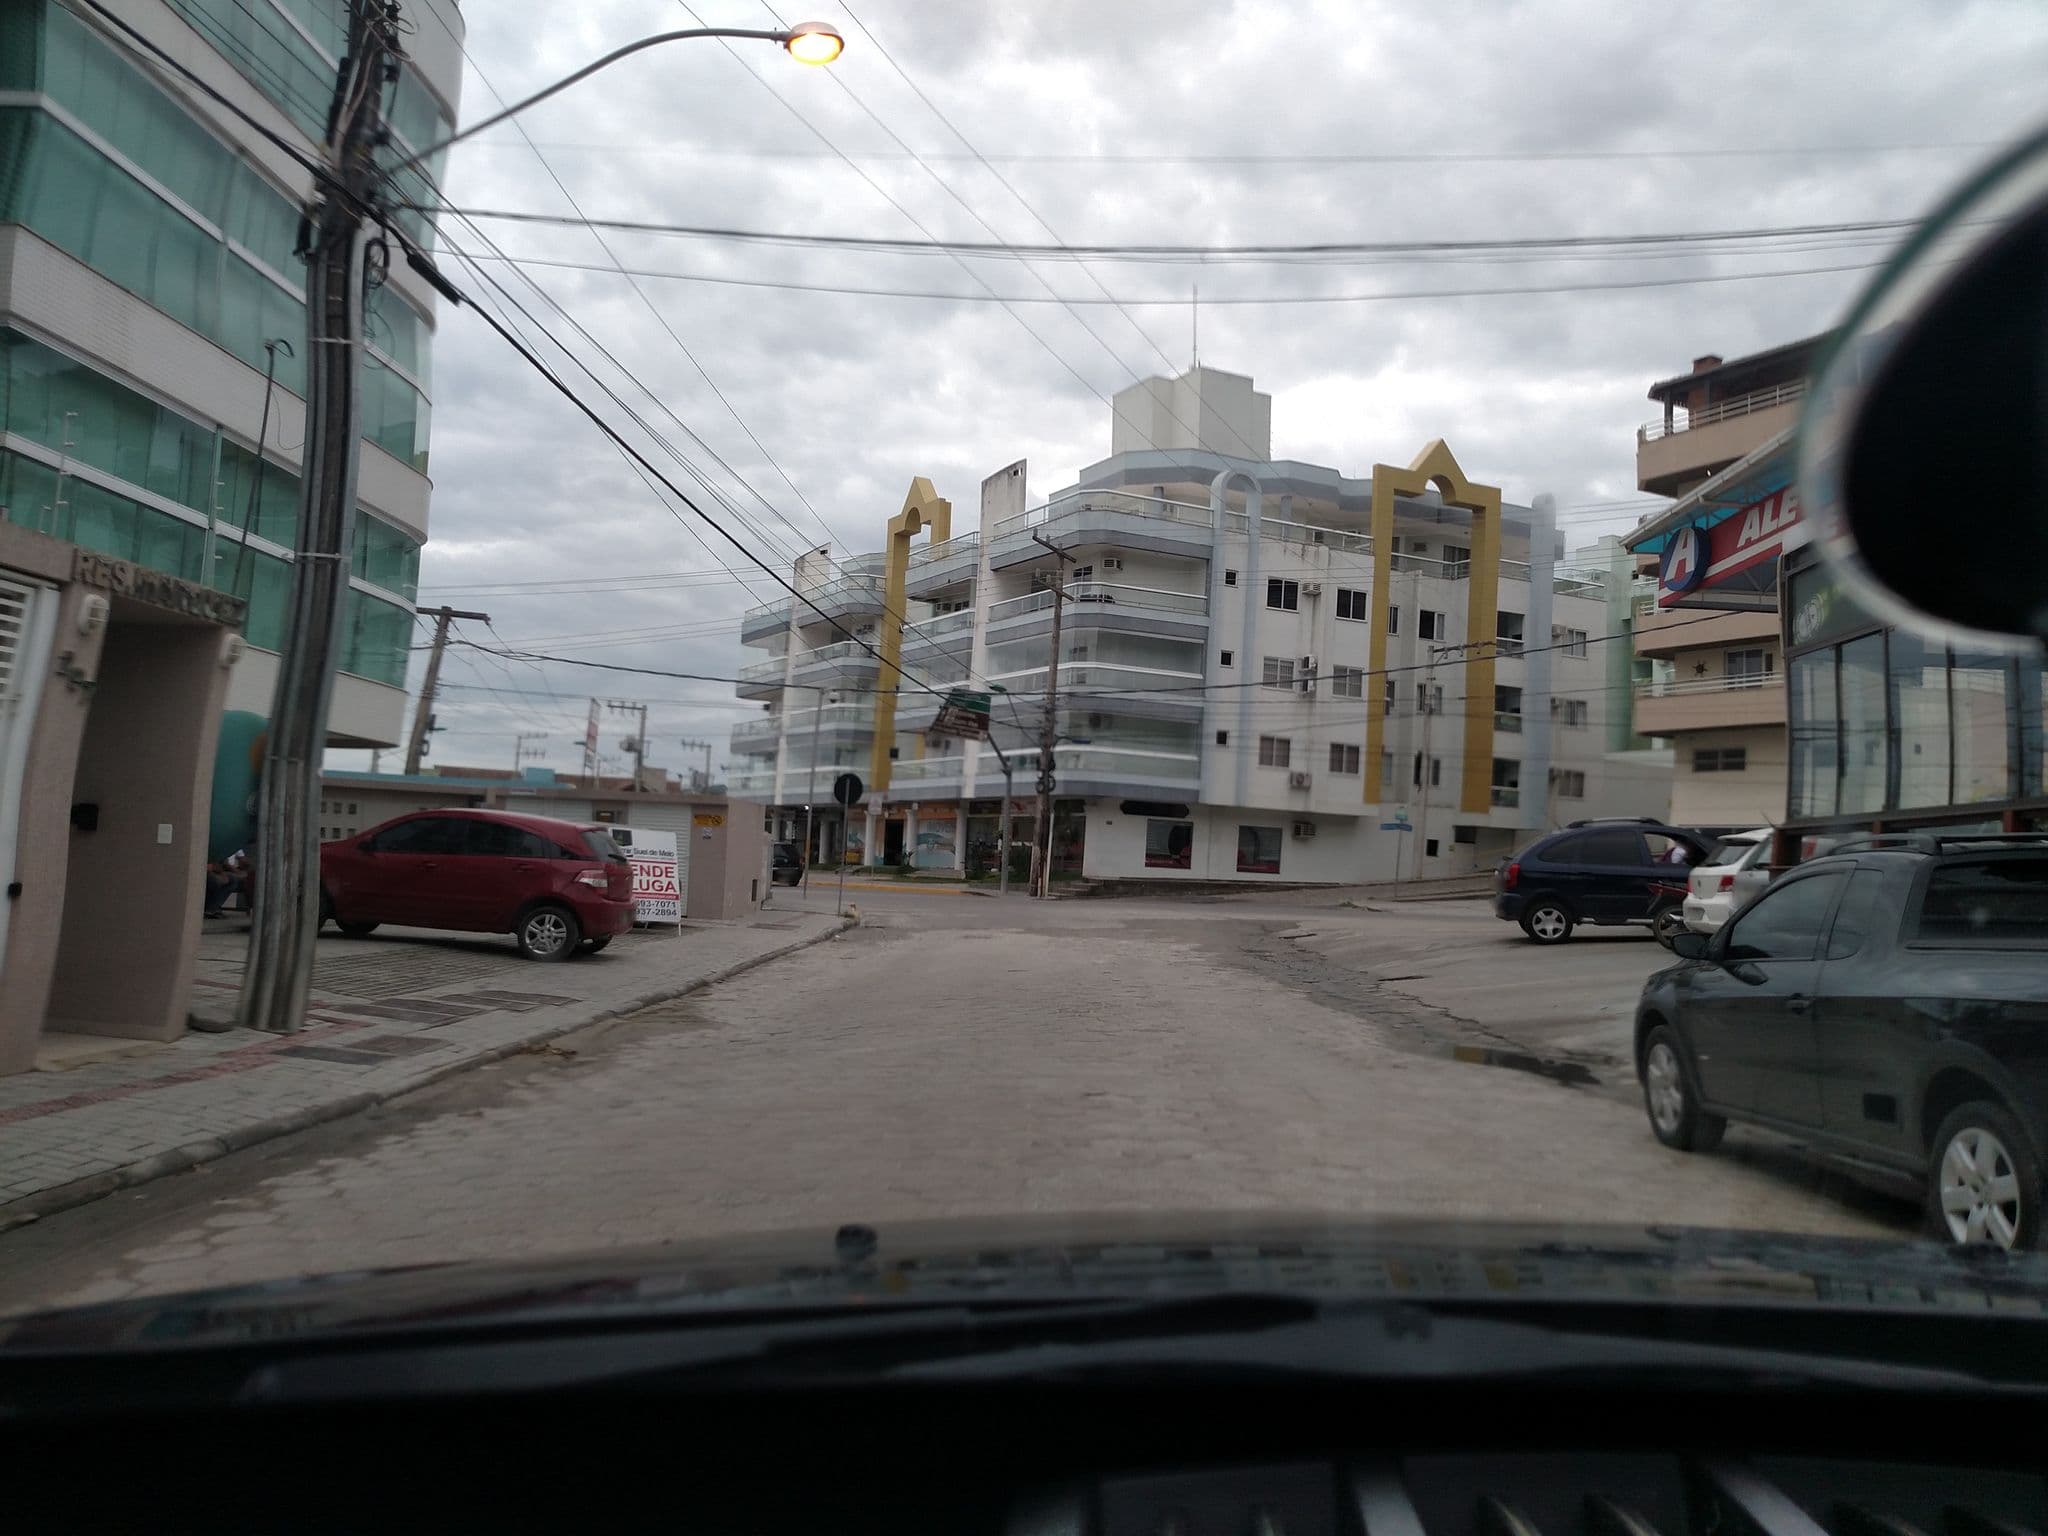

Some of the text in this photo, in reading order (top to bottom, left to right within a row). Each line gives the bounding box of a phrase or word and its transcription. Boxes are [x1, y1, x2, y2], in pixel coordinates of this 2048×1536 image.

[1736, 487, 1803, 549] ALE
[631, 864, 675, 878] ENDE
[631, 879, 677, 892] LUGA
